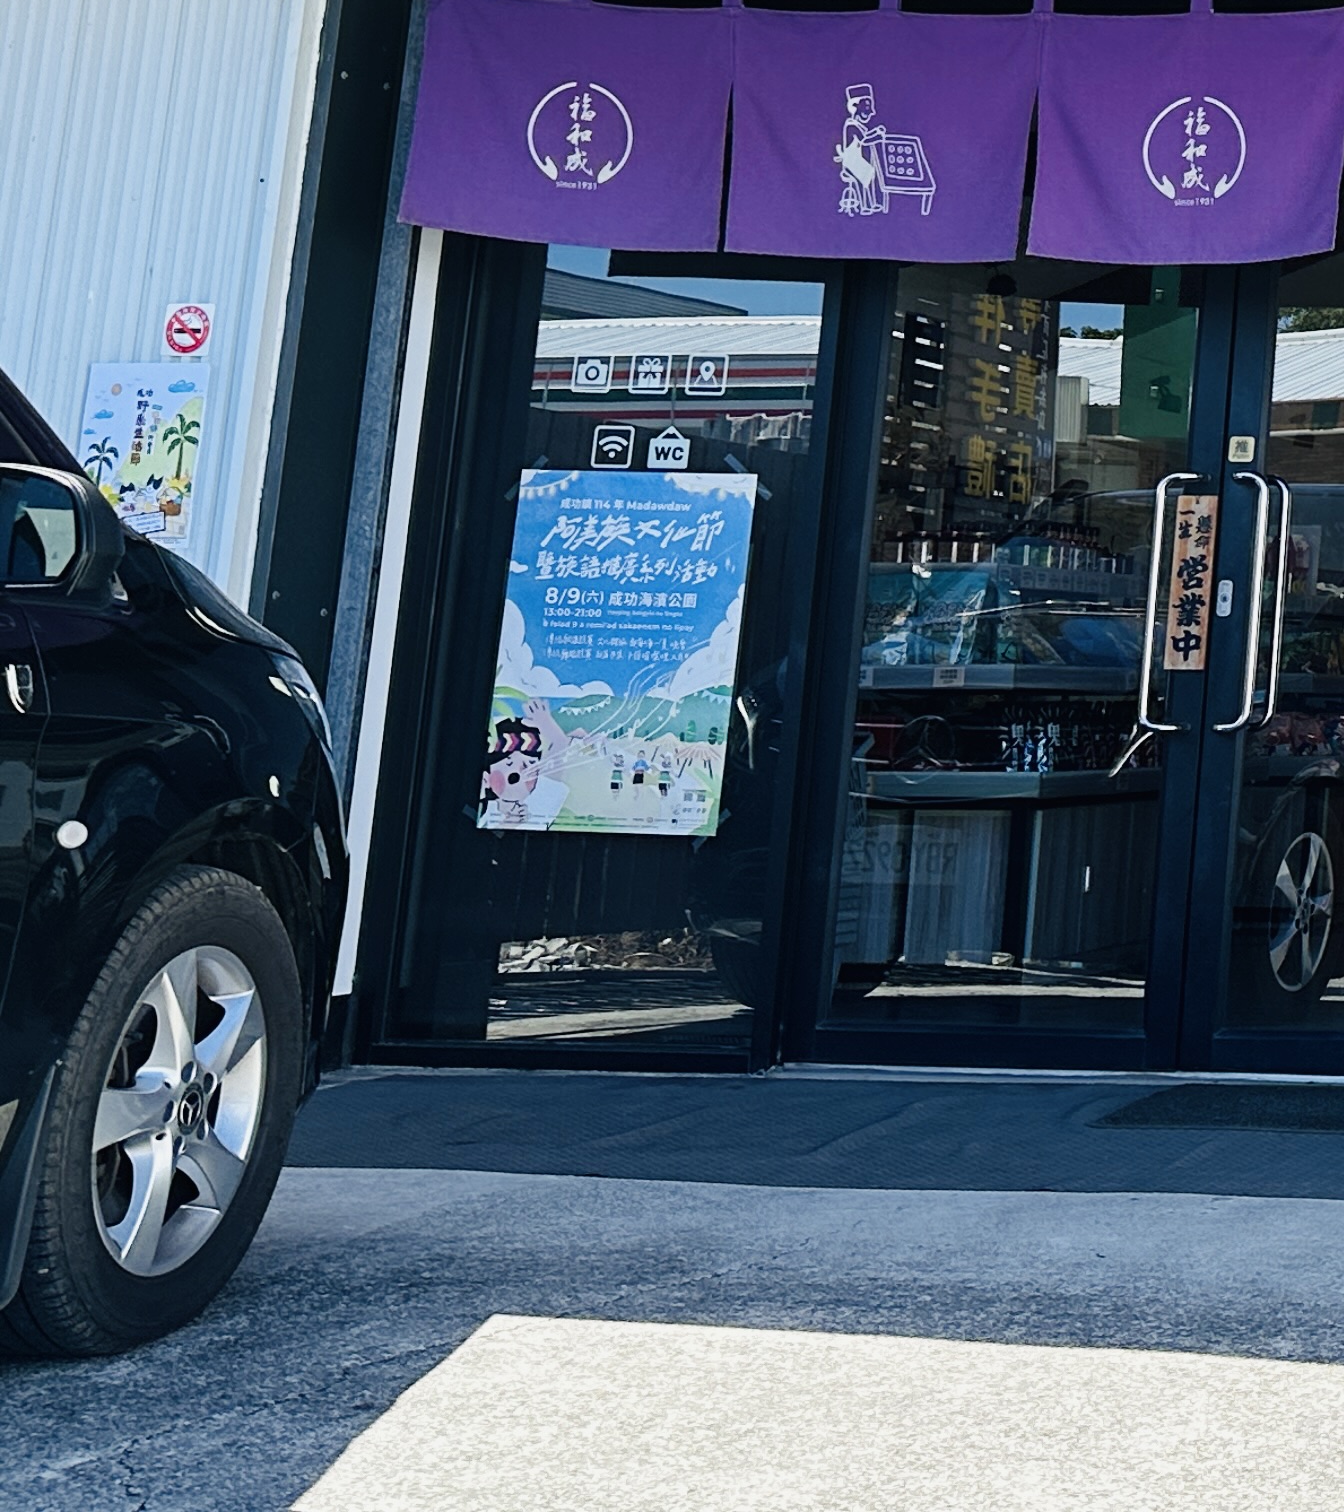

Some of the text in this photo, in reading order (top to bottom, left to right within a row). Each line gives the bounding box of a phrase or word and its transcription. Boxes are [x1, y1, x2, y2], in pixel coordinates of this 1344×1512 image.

[565, 92, 596, 176] 福和成
[1181, 107, 1211, 192] 福和成
[655, 446, 684, 461] WC
[594, 499, 611, 509] 114
[613, 499, 625, 510] 年
[626, 501, 692, 512] Madawdaw
[540, 510, 725, 552] 阿美族文化節
[545, 587, 697, 608] 8/9(六) 成功海濱公園
[543, 608, 602, 617] 13:00-21:00
